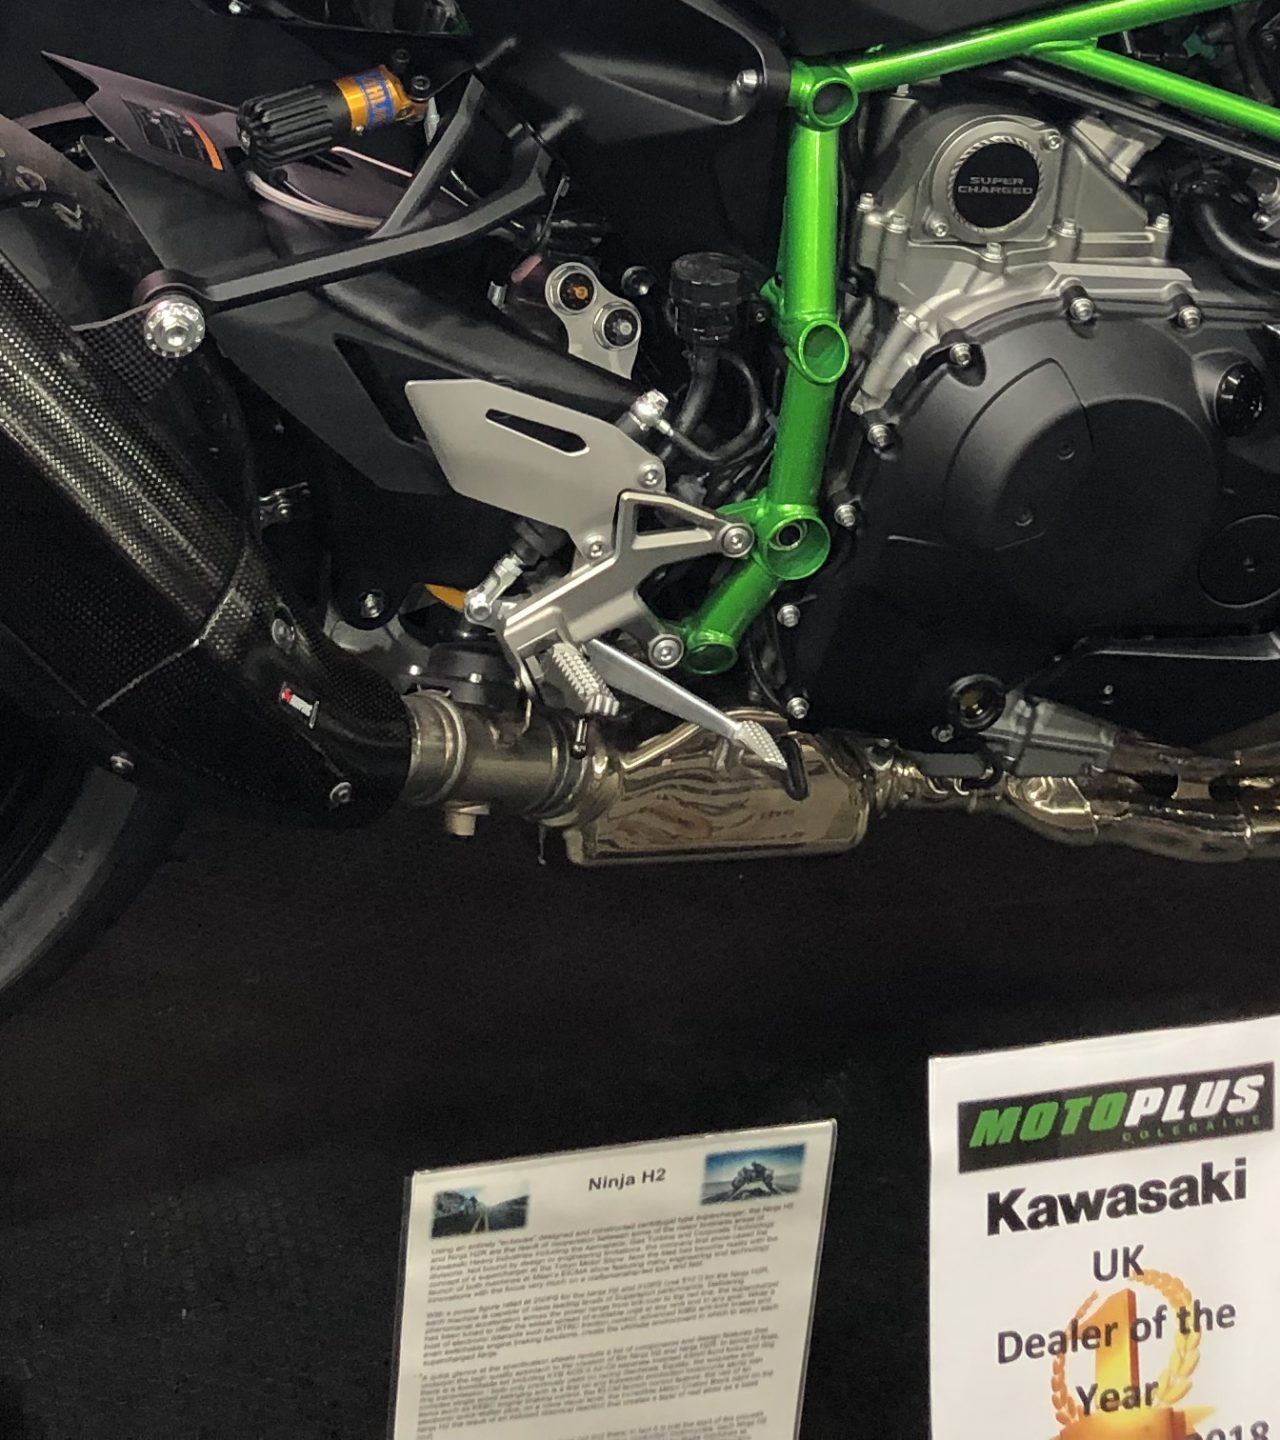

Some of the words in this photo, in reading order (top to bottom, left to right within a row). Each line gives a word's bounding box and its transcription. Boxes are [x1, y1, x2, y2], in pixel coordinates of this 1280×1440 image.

[957, 185, 1034, 195] CHARGED
[969, 176, 1025, 185] SUPER
[1122, 1114, 1262, 1143] COLERAINE
[587, 1172, 636, 1192] Ninja
[642, 1168, 667, 1184] H2
[986, 1157, 1248, 1237] Kawasaki
[1092, 1244, 1146, 1283] UK
[997, 1317, 1120, 1364] Dealer
[1130, 1304, 1169, 1343] of
[1176, 1300, 1237, 1336] the
[1075, 1379, 1160, 1417] Year
